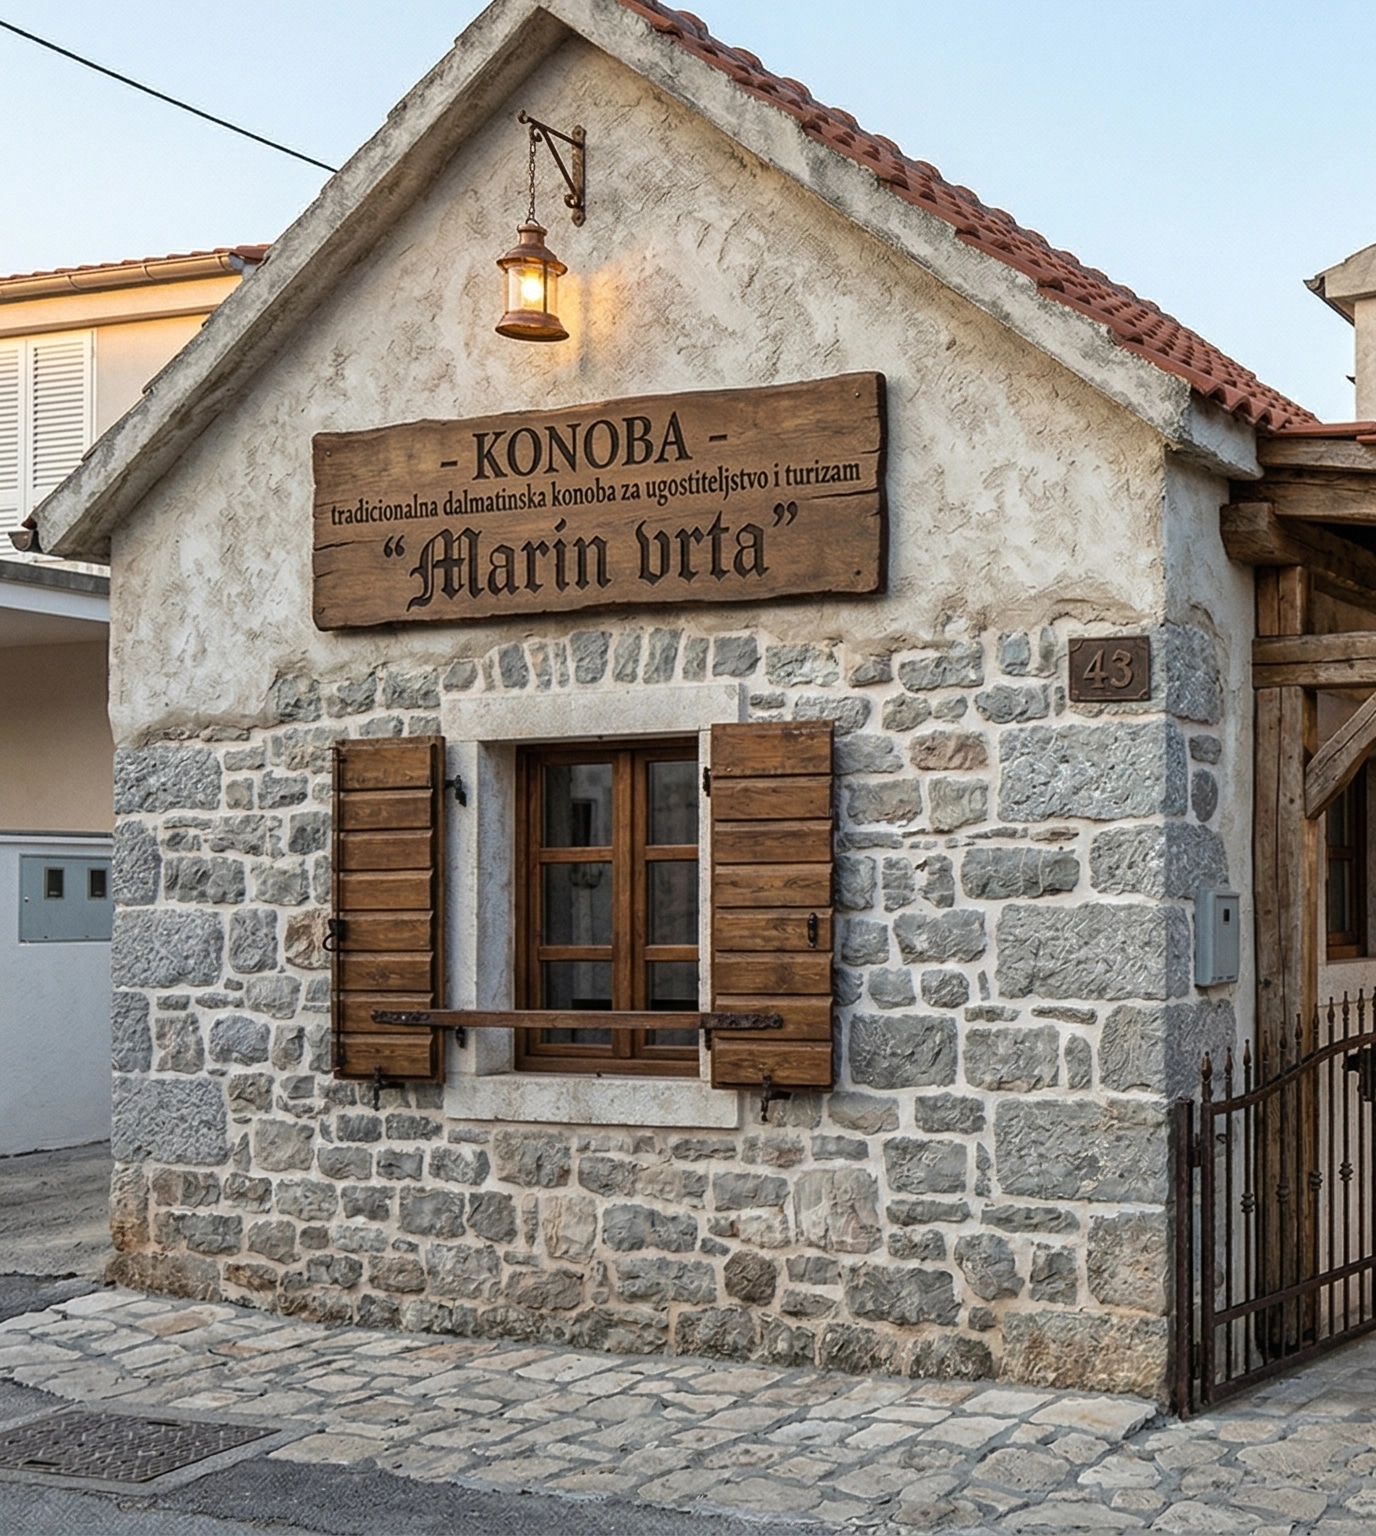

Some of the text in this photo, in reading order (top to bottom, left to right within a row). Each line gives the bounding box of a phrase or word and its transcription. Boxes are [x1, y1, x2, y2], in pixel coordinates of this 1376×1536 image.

[471, 410, 693, 481] KONOBA
[331, 459, 862, 526] tradicionalna dalmatinska konoba za ugostiteljstvo i turizam
[1083, 648, 1134, 690] 43
